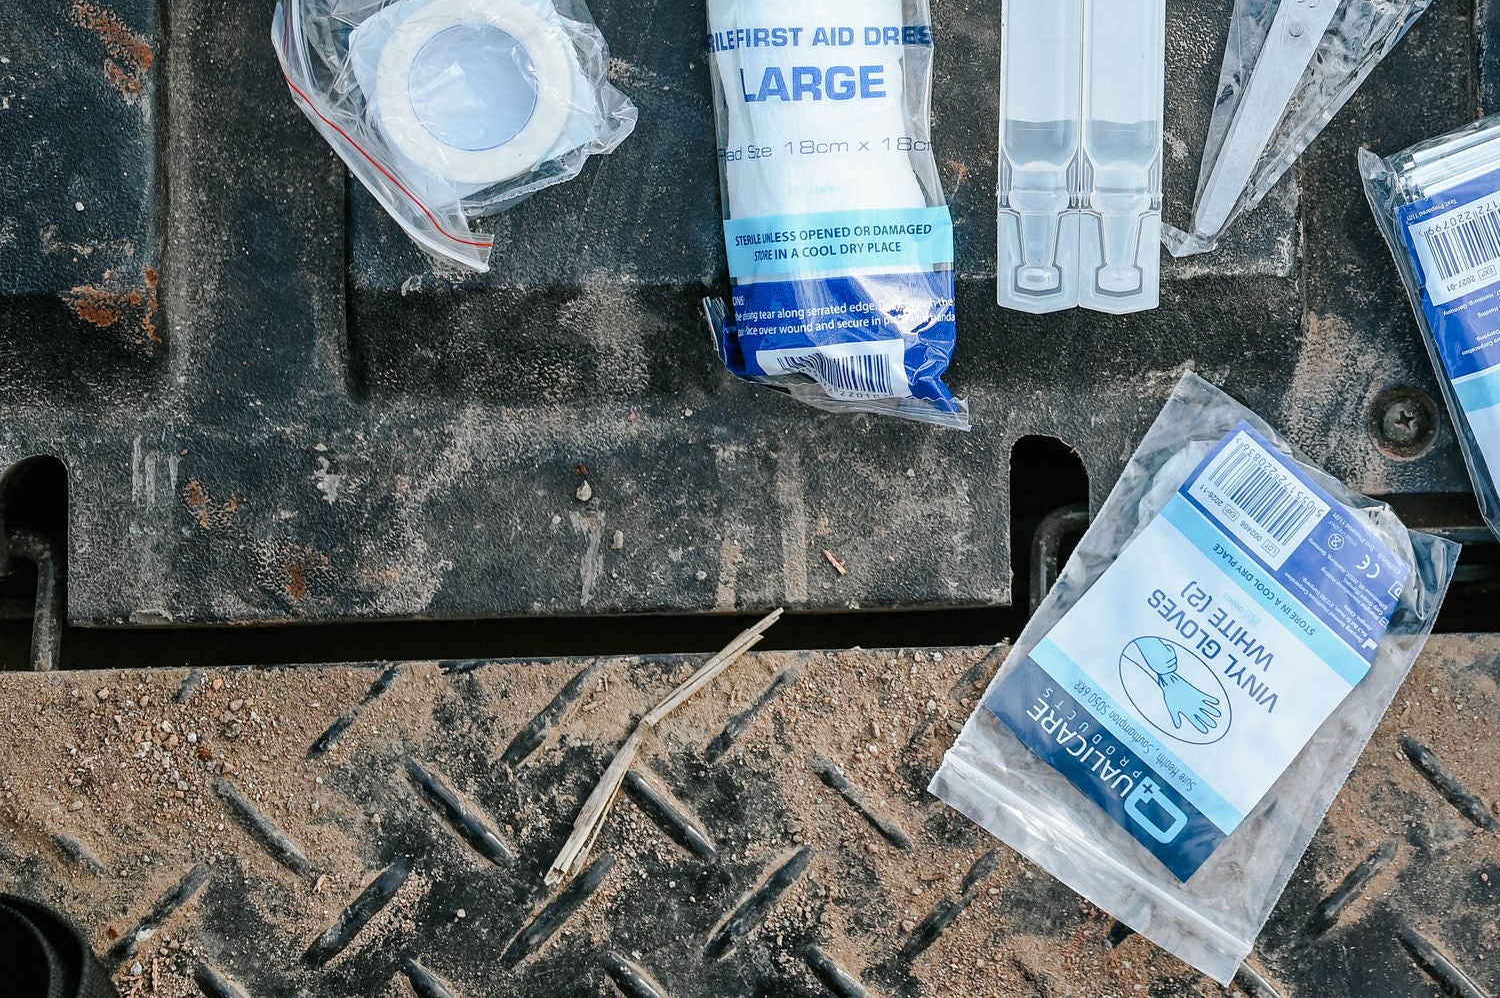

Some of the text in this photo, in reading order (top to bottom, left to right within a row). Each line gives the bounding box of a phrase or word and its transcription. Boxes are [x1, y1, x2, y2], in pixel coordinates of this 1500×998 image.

[736, 27, 803, 49] FIRST
[812, 26, 854, 46] AID
[740, 65, 886, 103] LARGE
[784, 140, 848, 155] 18cm
[859, 141, 870, 152] x
[735, 224, 932, 247] STERILE UNLESS OPENED OR DAMAGED
[754, 241, 901, 262] STORE IN A COOL DRY PLACE
[1446, 274, 1476, 292] 2027-01
[759, 310, 775, 320] tear
[777, 308, 804, 321] along
[807, 303, 847, 317] serrated
[759, 326, 777, 335] over
[779, 322, 813, 334] wound
[815, 318, 835, 331] and
[837, 317, 869, 328] secure
[871, 316, 881, 326] in
[1199, 483, 1223, 506] 2026-11
[1212, 542, 1238, 567] PLACE
[1235, 565, 1254, 582] DRY
[1180, 580, 1213, 613] (2)
[1253, 578, 1275, 600] COOL
[1273, 597, 1283, 606] A
[1279, 603, 1292, 615] IN
[1147, 589, 1221, 659] GLOVES
[1288, 611, 1316, 636] STORE
[1207, 607, 1274, 670] WHITE
[1073, 679, 1092, 697] 6RR
[1224, 653, 1278, 712] VINYL
[1043, 689, 1141, 776] PRODUCTS
[1108, 710, 1154, 754] Southampton
[1026, 697, 1187, 844] QUALICARE
[1177, 772, 1196, 791] Sure
